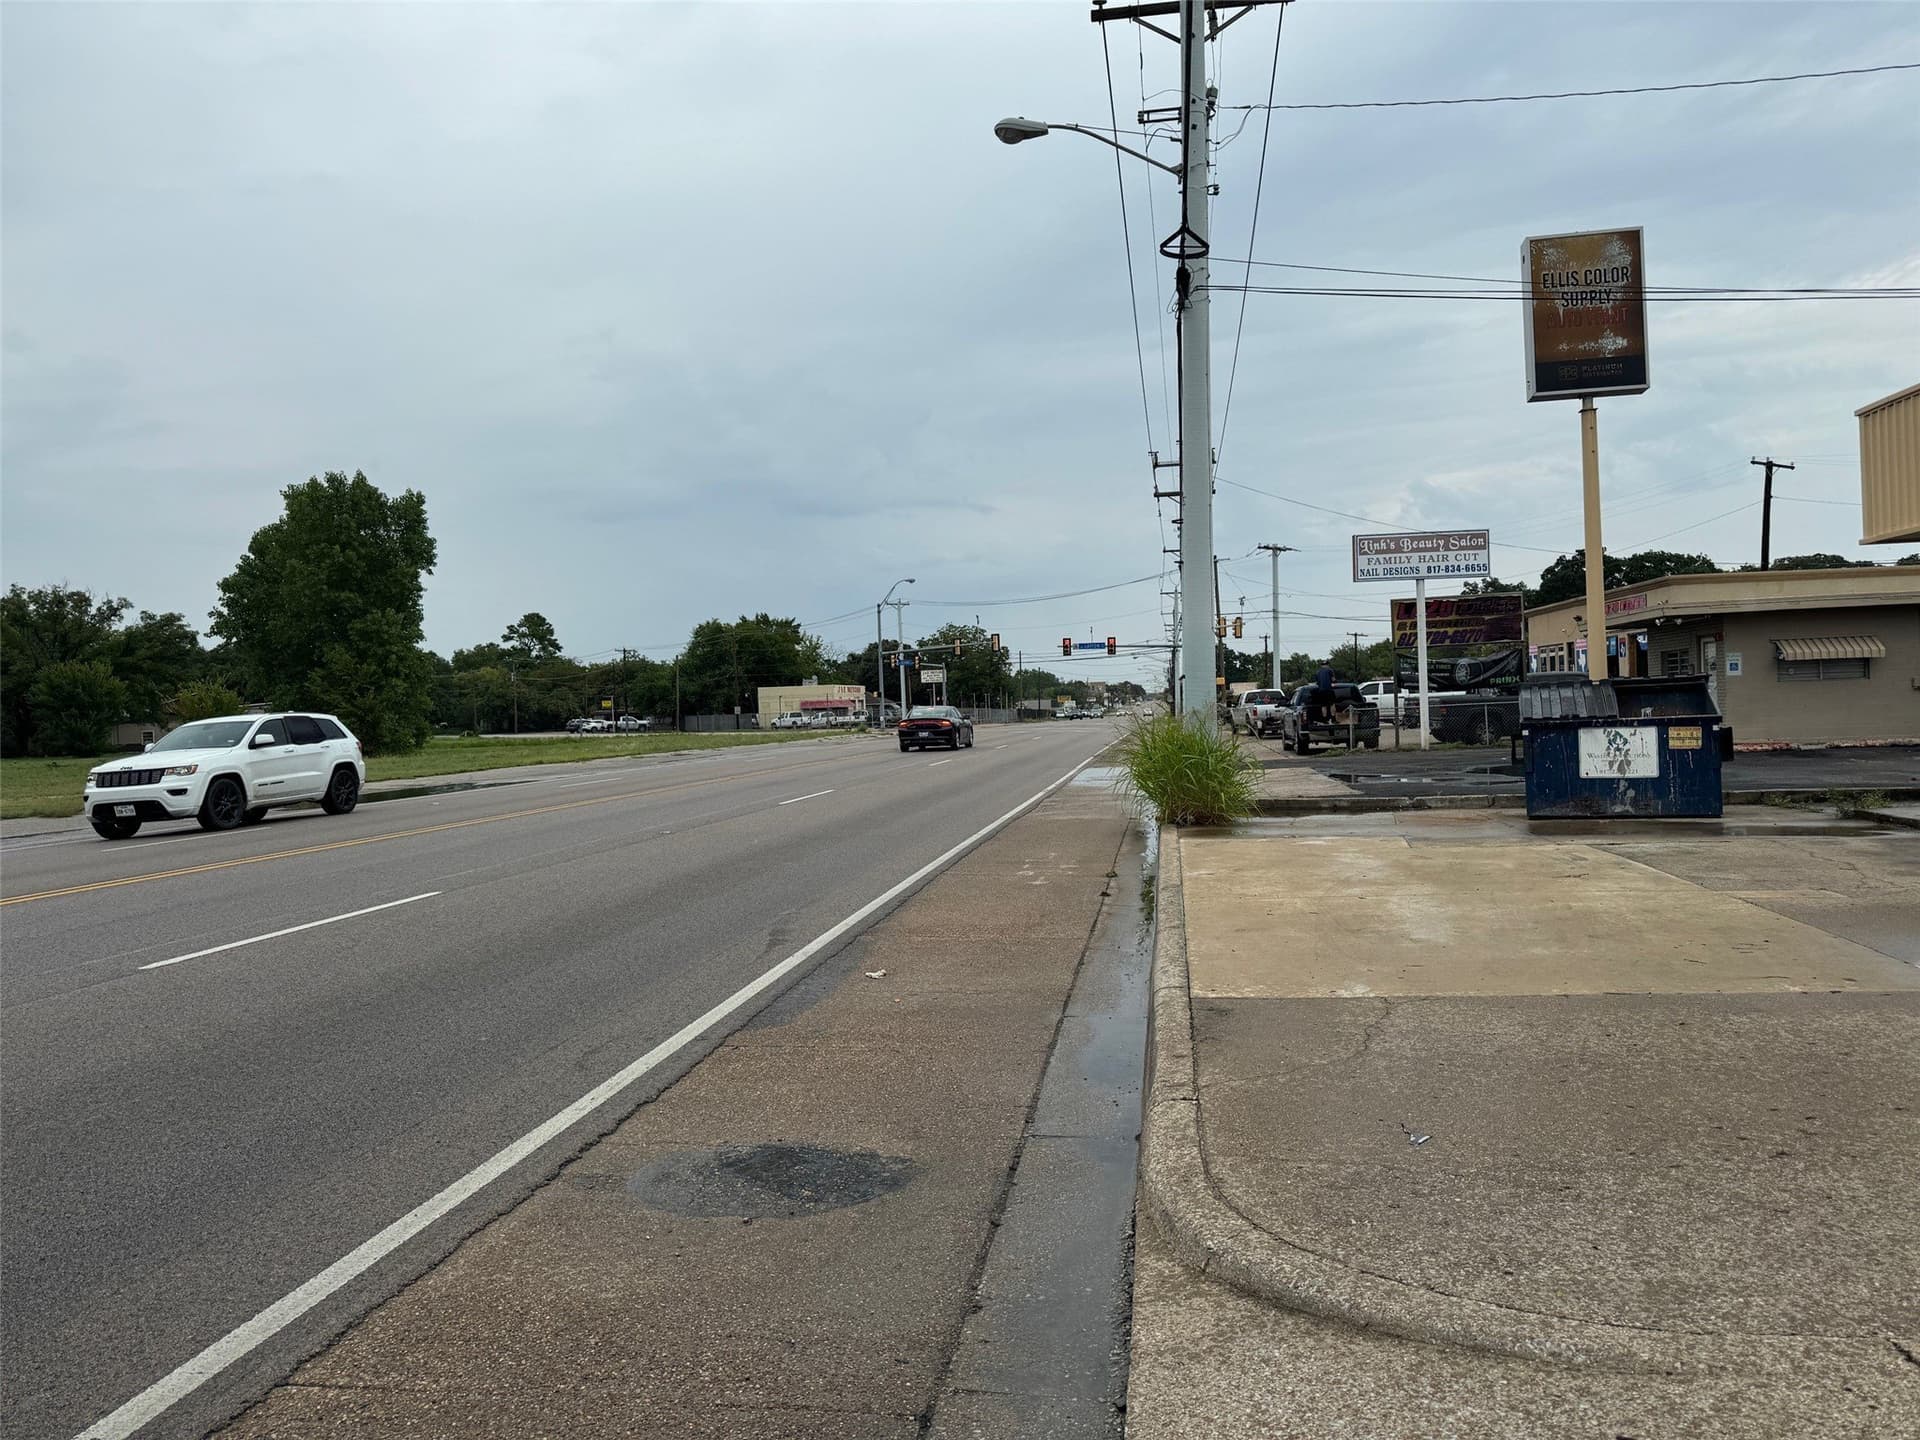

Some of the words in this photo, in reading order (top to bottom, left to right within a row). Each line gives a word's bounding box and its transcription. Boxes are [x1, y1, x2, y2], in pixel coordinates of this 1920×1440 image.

[1542, 270, 1579, 289] ELLIS
[1584, 266, 1630, 286] COLOR
[1561, 288, 1613, 308] SUPPLY
[1399, 537, 1445, 552] Beauty
[1449, 535, 1485, 550] Salon
[1367, 555, 1413, 566] FAMILY
[1418, 554, 1450, 564] HAIR
[1454, 552, 1480, 562] CUT
[1360, 567, 1380, 577] NAIL
[1383, 565, 1421, 577] DESIGNS
[1426, 563, 1488, 574] 817-834-6655
